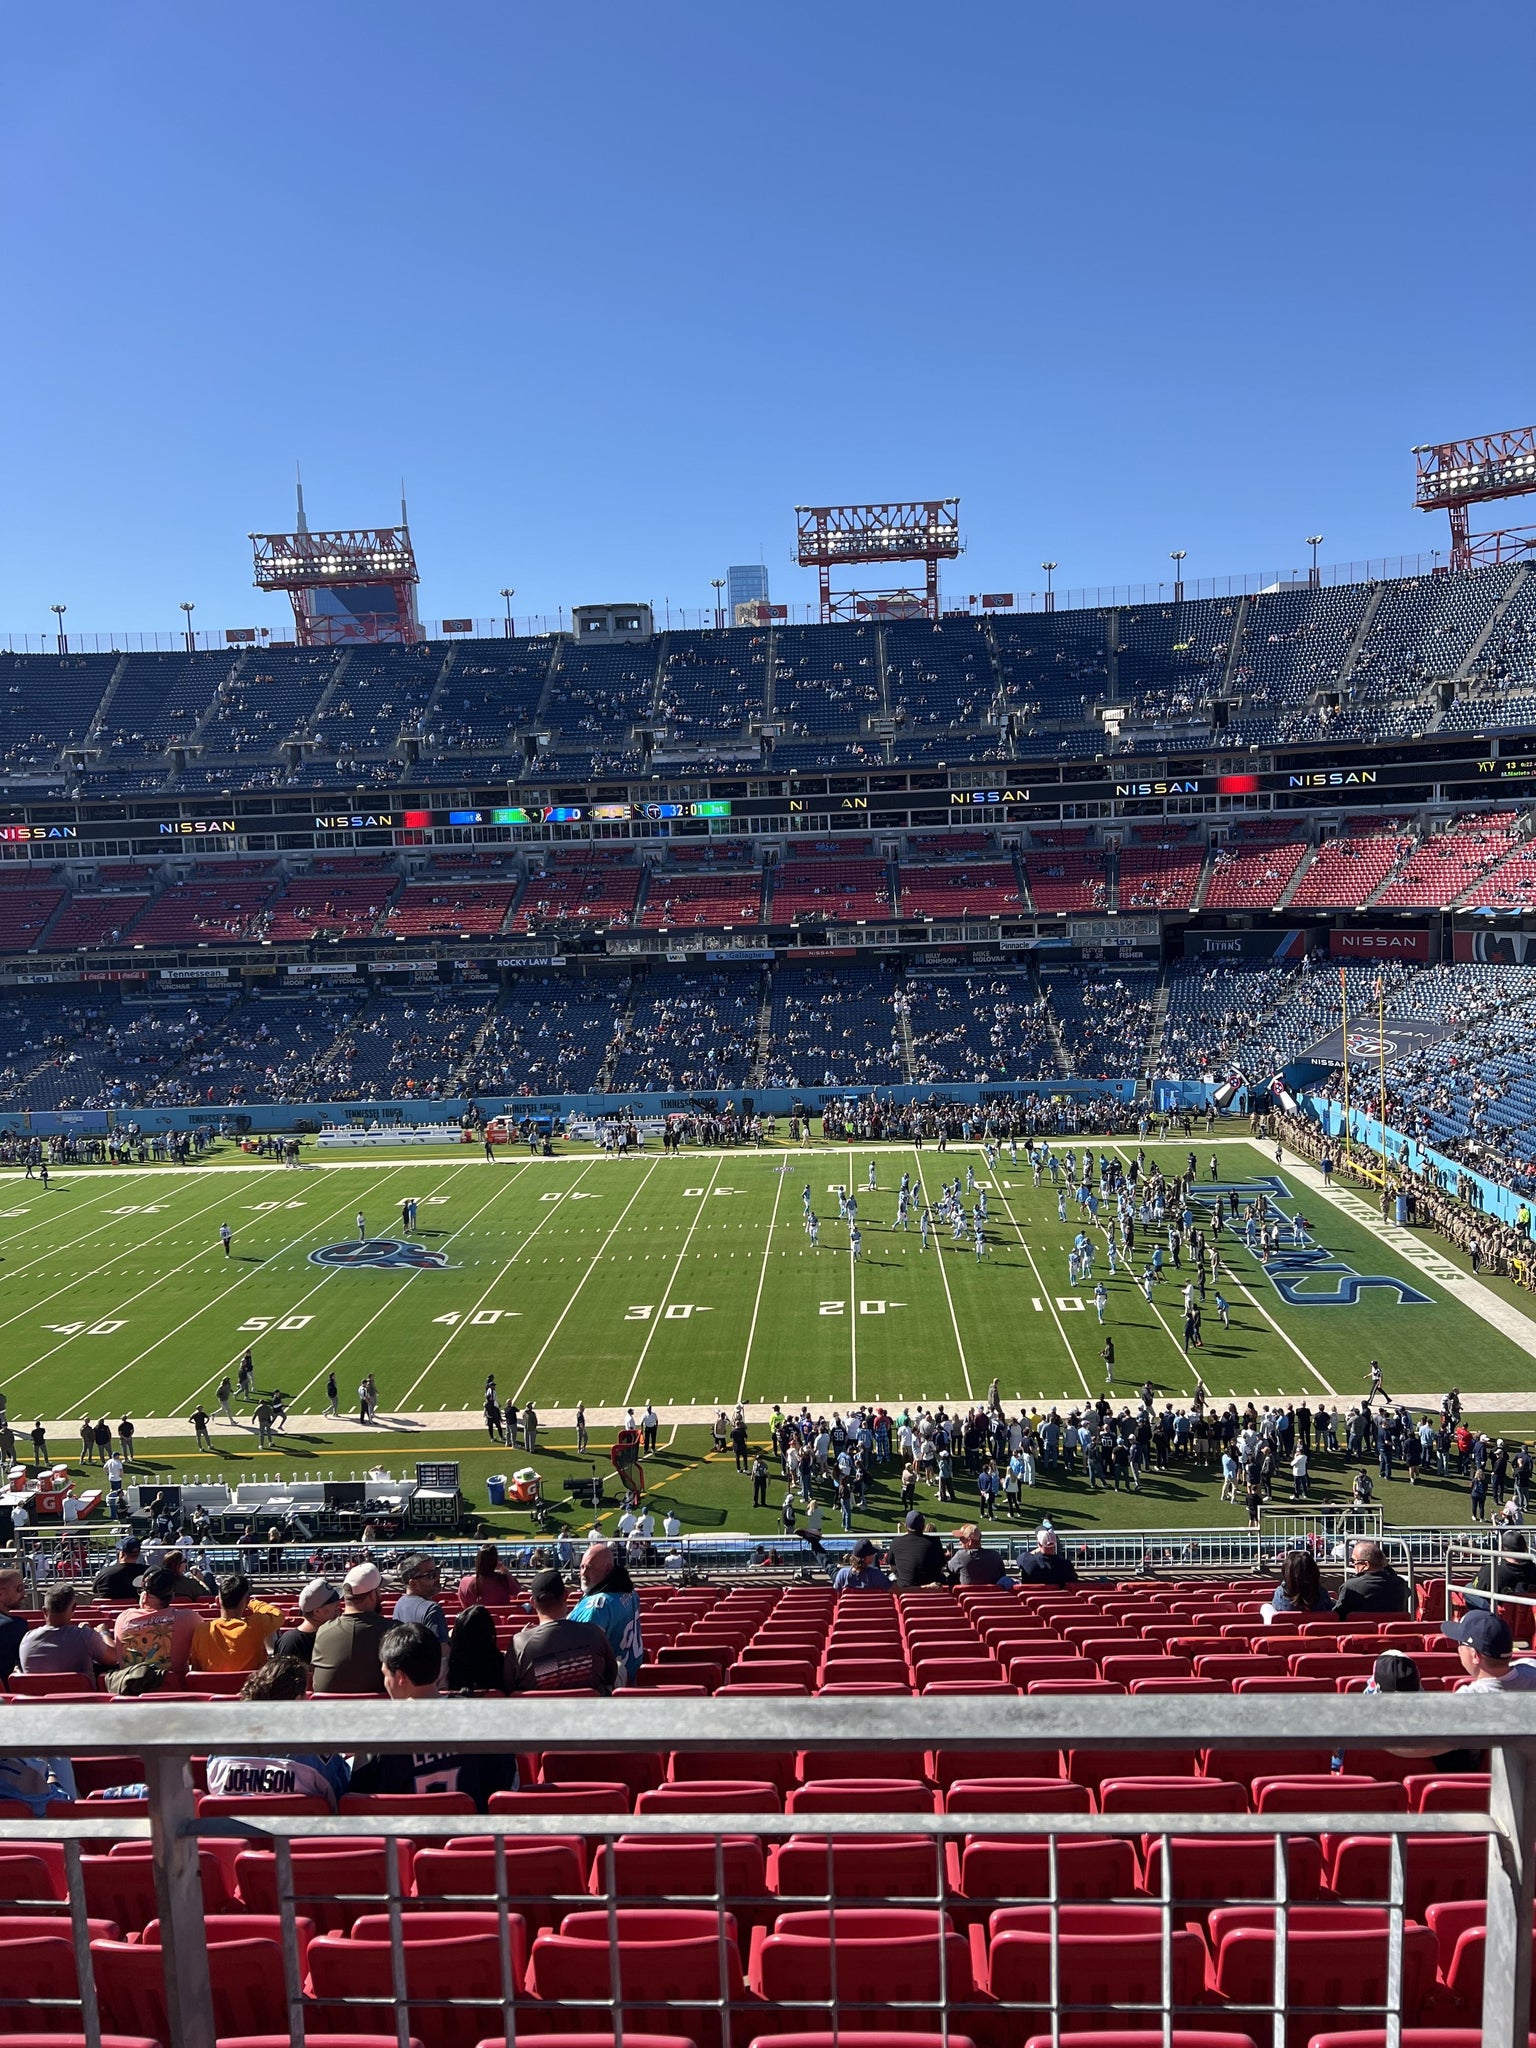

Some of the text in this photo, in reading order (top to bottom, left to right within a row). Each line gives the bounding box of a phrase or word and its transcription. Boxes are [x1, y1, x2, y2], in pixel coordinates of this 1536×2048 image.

[1289, 771, 1377, 787] NISSAN
[1116, 781, 1199, 797] NISSAN
[950, 790, 1030, 804] NISSAN
[160, 820, 235, 833] NISSAN
[315, 815, 392, 828] NISSAN
[0, 827, 77, 840] NISSAN
[1204, 938, 1241, 951] TITANS
[1342, 936, 1416, 947] NISSAN
[729, 951, 765, 959] Gallagher
[454, 960, 477, 969] FedEx
[497, 958, 527, 967] ROCKY
[1355, 1027, 1430, 1038] NISSAN
[344, 1107, 380, 1119] TENNESSEE
[1373, 1224, 1413, 1244] ALL
[1401, 1246, 1440, 1264] OF
[1424, 1264, 1466, 1282] US
[527, 1483, 537, 1496] G
[42, 1496, 56, 1510] G
[224, 1769, 296, 1793] JOHNSON
